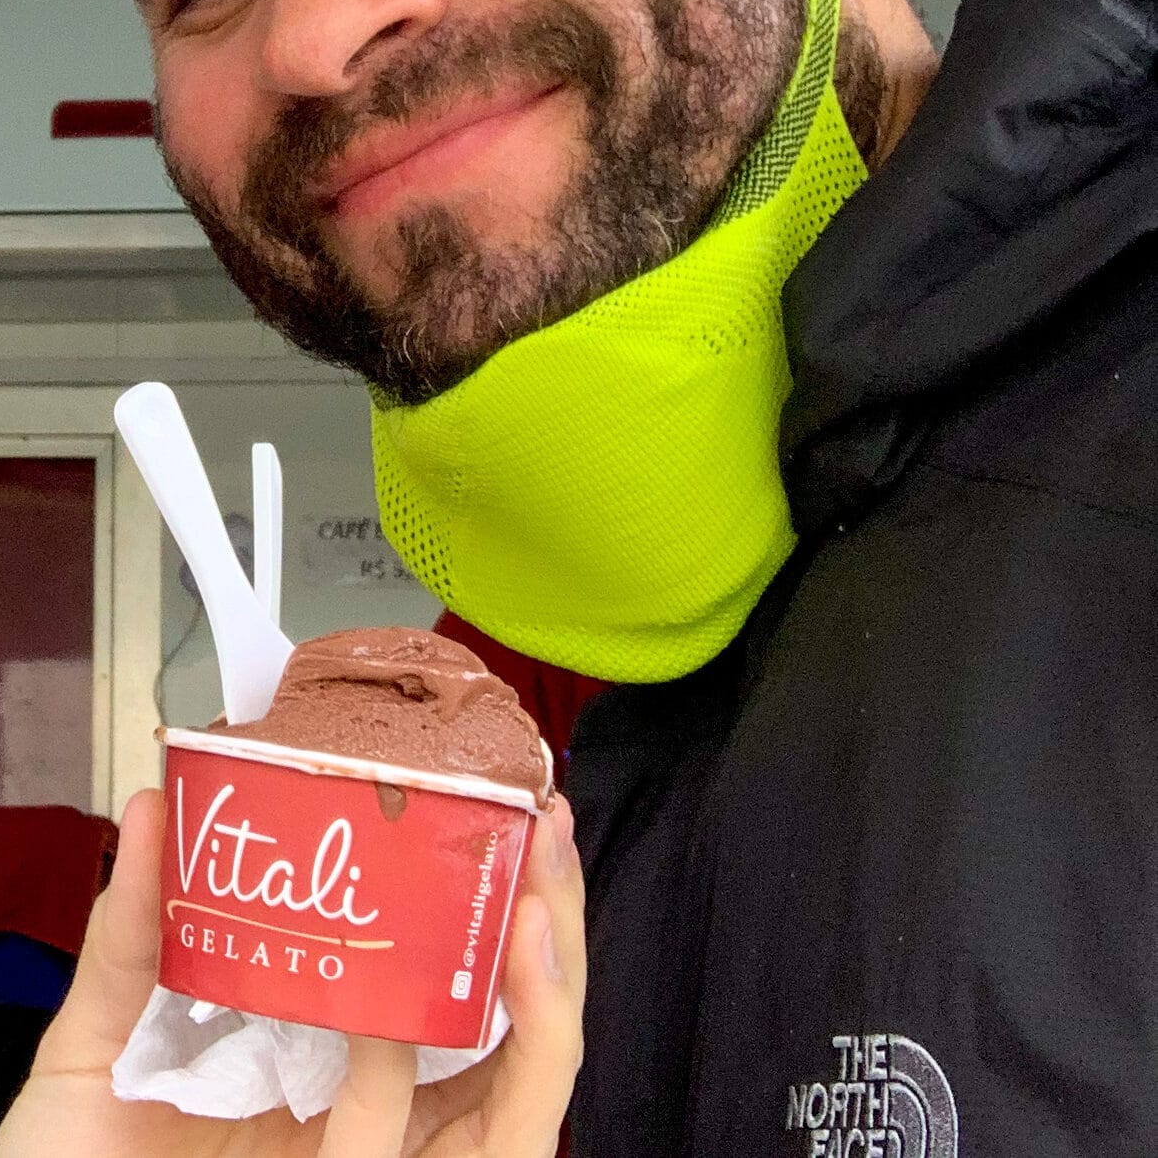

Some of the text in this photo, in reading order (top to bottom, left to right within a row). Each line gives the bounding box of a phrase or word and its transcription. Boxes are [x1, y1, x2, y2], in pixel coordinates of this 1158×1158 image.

[177, 776, 380, 926] Vitali
[462, 830, 500, 968] @vitaligelato
[180, 922, 345, 981] GELATO
[832, 1035, 889, 1080] THE
[785, 1082, 889, 1131] NORTH
[809, 1128, 886, 1158] FACE
